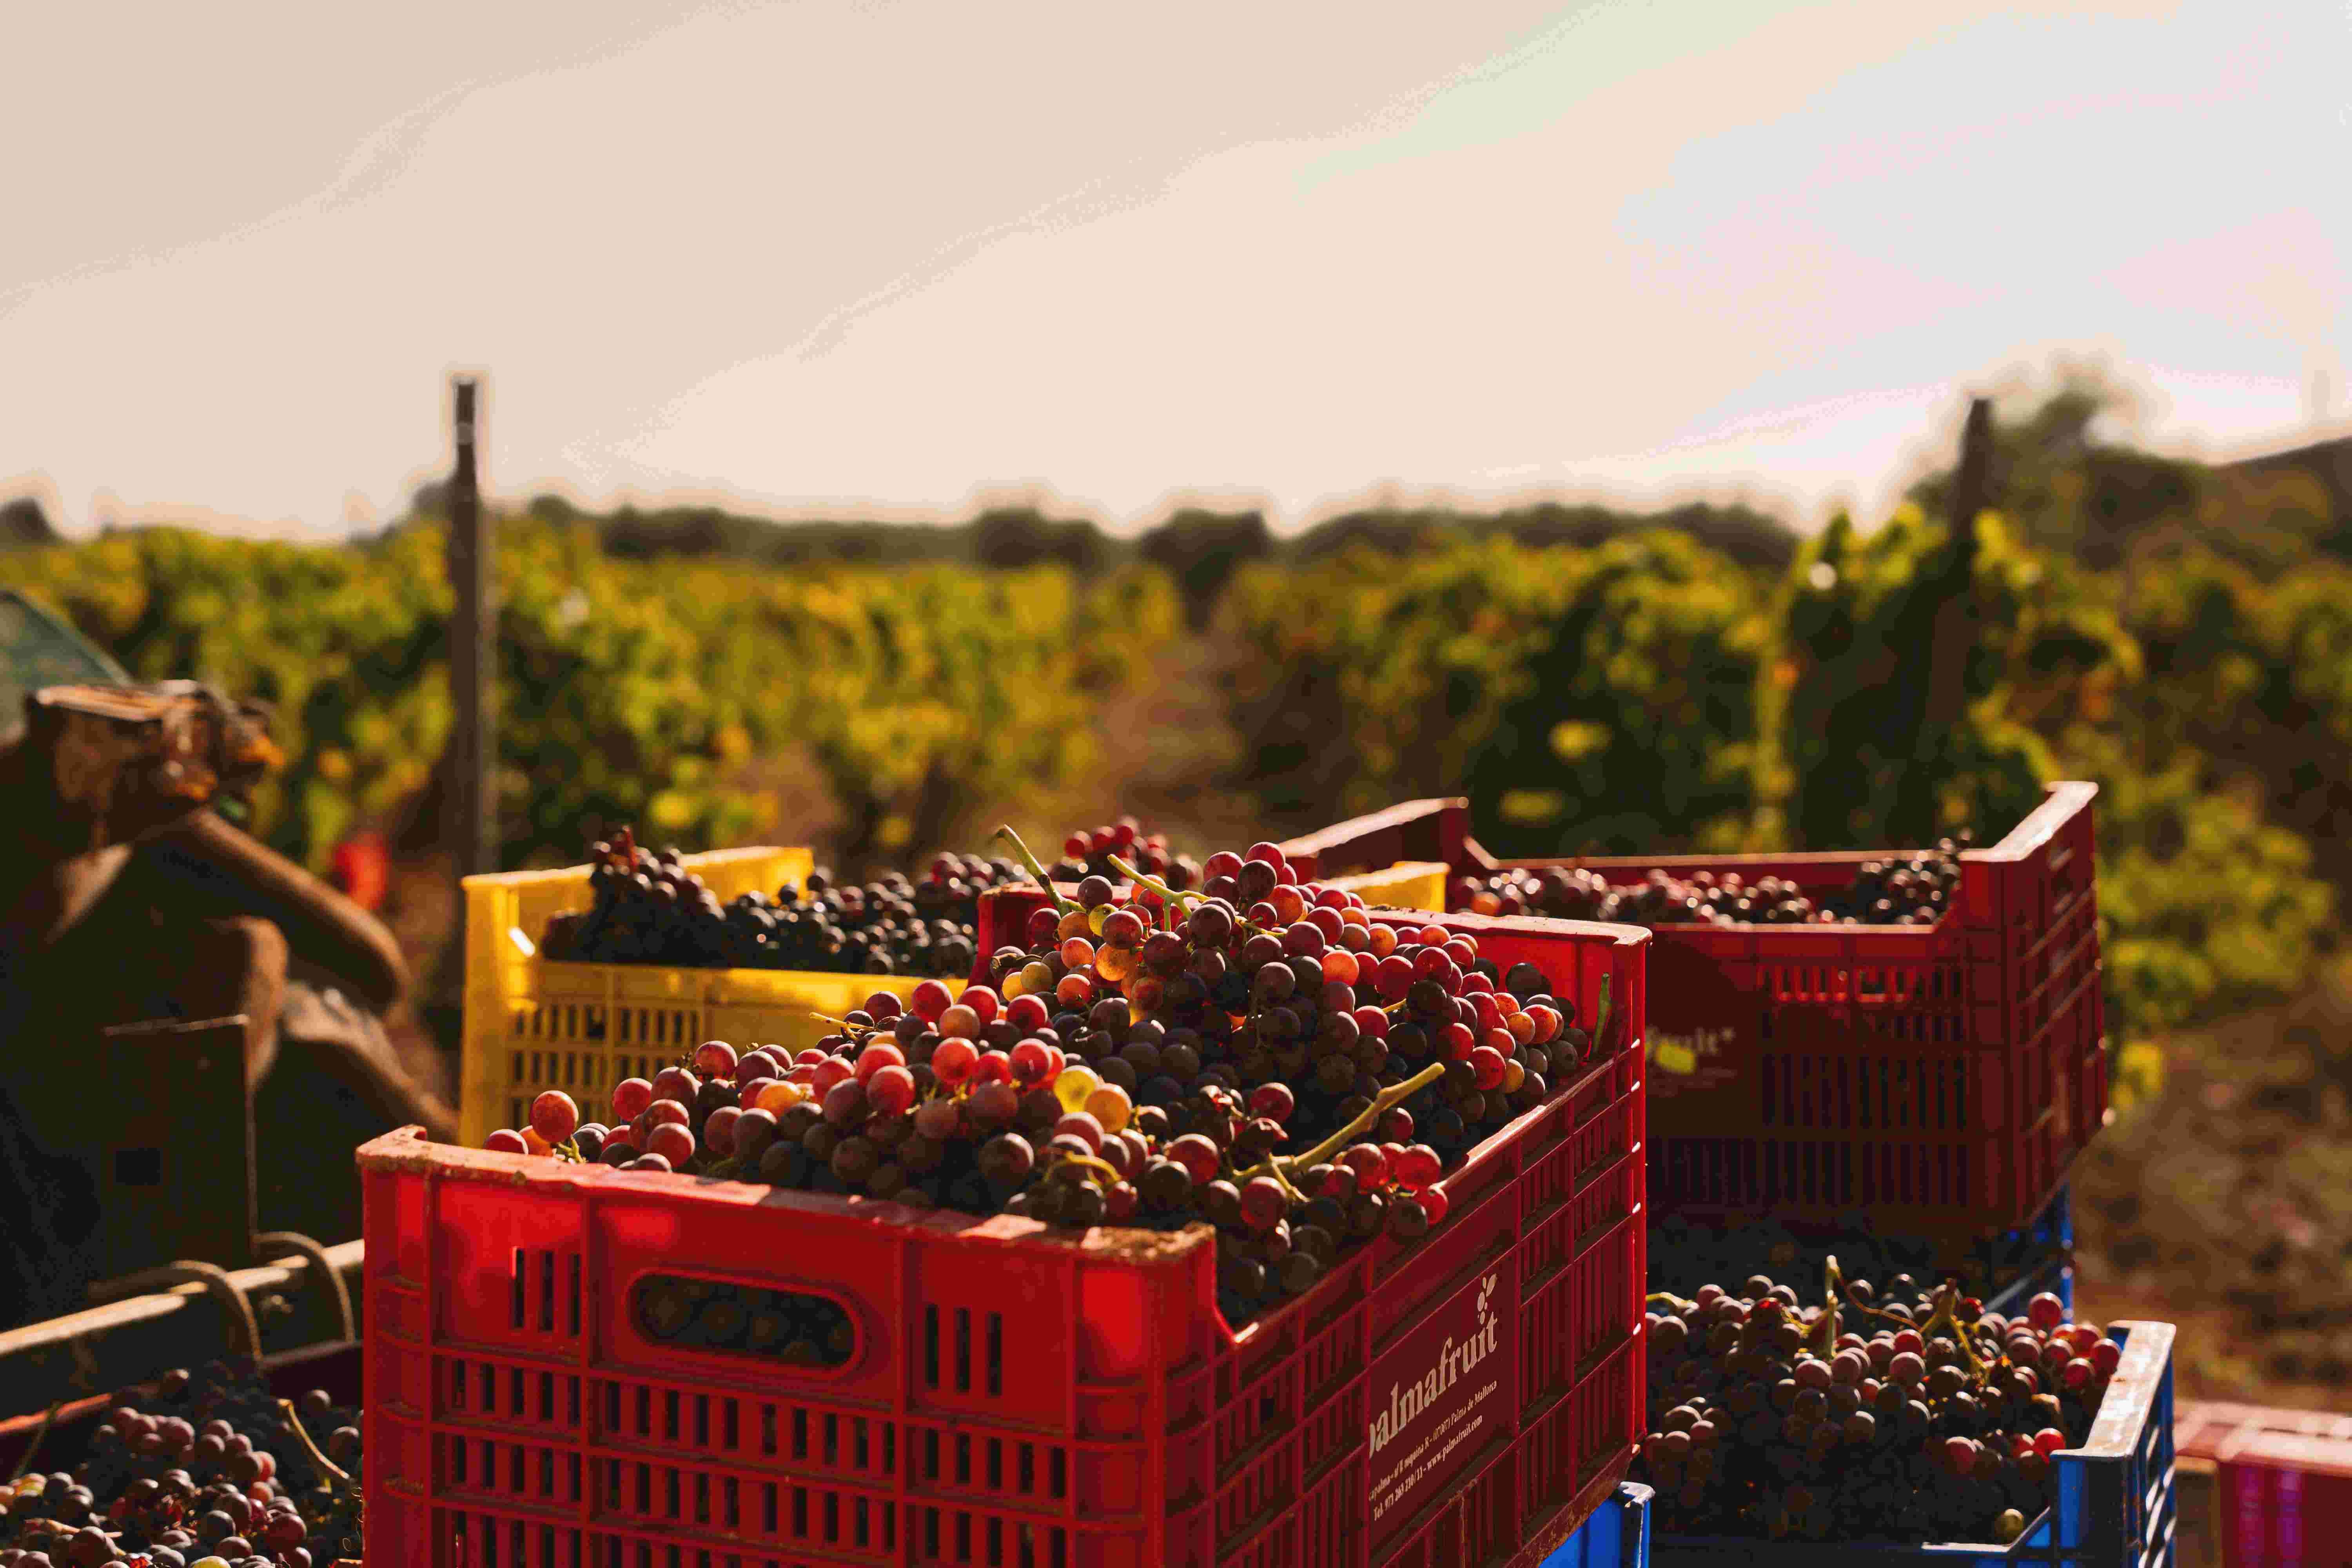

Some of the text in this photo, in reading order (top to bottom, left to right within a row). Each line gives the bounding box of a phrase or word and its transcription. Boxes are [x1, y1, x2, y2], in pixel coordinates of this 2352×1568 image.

[1451, 1406, 1466, 1426] Palma
[1467, 1398, 1474, 1411] de
[1474, 1380, 1497, 1405] Mallorca
[1426, 1415, 1483, 1471] www.palmafruit.com
